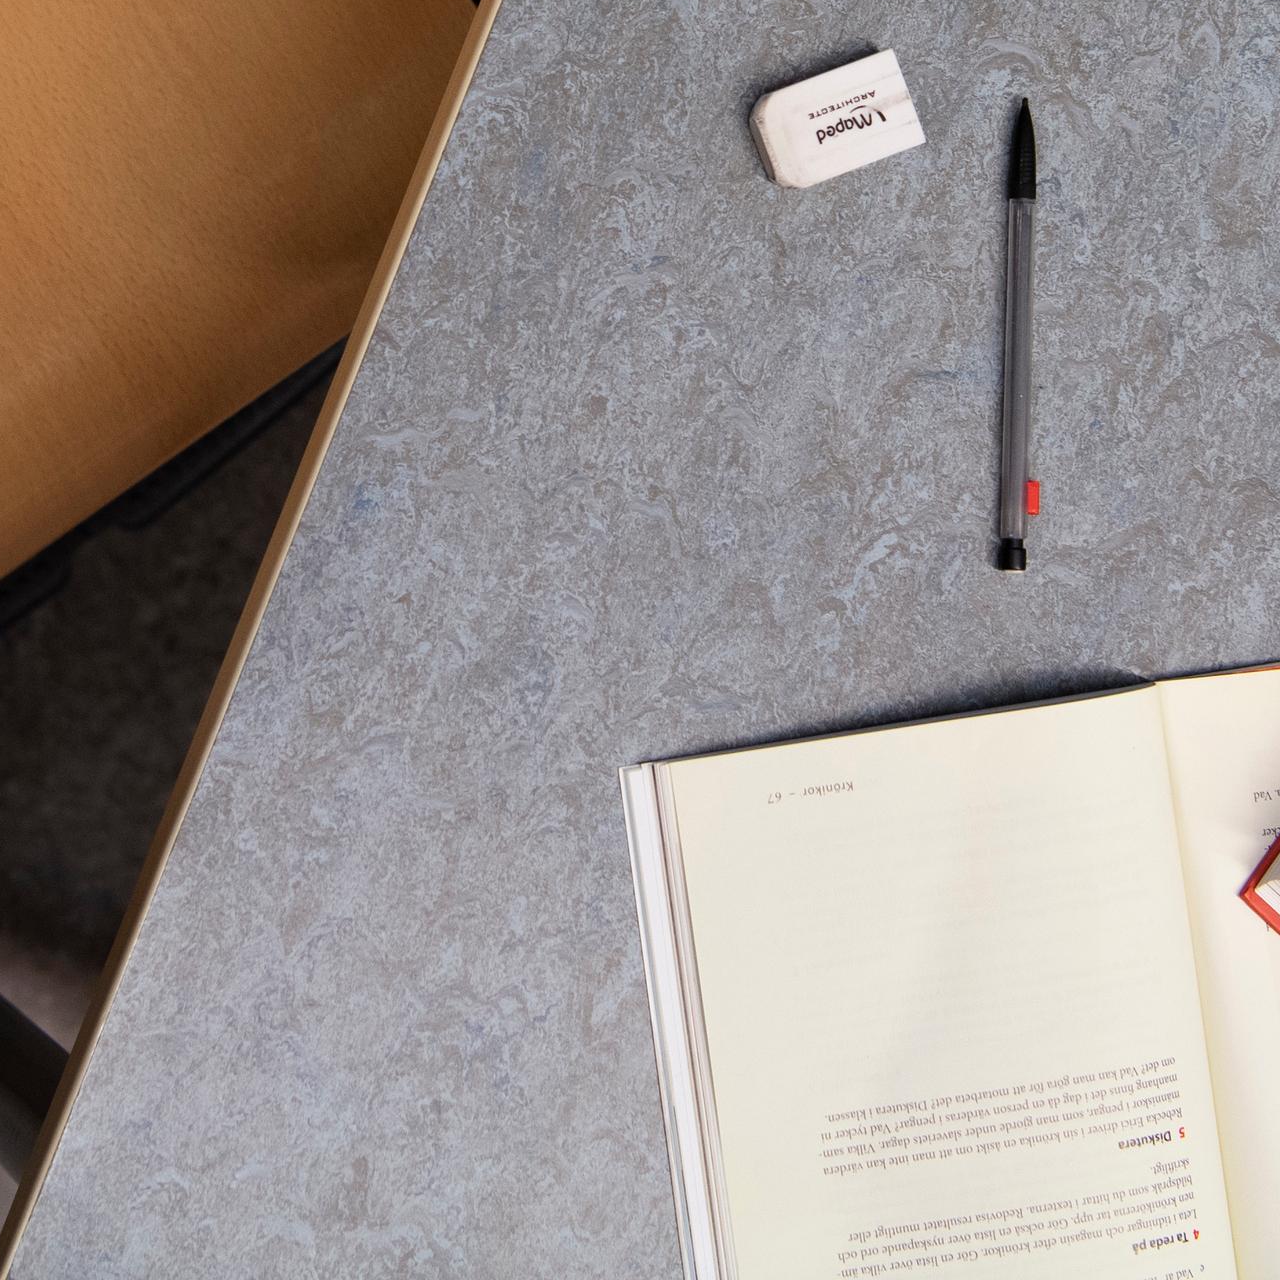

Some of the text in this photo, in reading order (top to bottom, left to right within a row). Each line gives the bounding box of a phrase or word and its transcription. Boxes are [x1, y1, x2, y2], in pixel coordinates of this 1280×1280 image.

[807, 89, 876, 120] ARCHITECTE
[815, 108, 887, 145] Maped
[767, 791, 782, 805] 67
[802, 781, 854, 797] Krönikor
[823, 1107, 1183, 1177] Rebecka Erici driver i sin krönika en åsikt om att man inte kan värdera
[1118, 1126, 1186, 1150] 5 Diskutera
[1132, 1228, 1201, 1256] 4 Ta reda på
